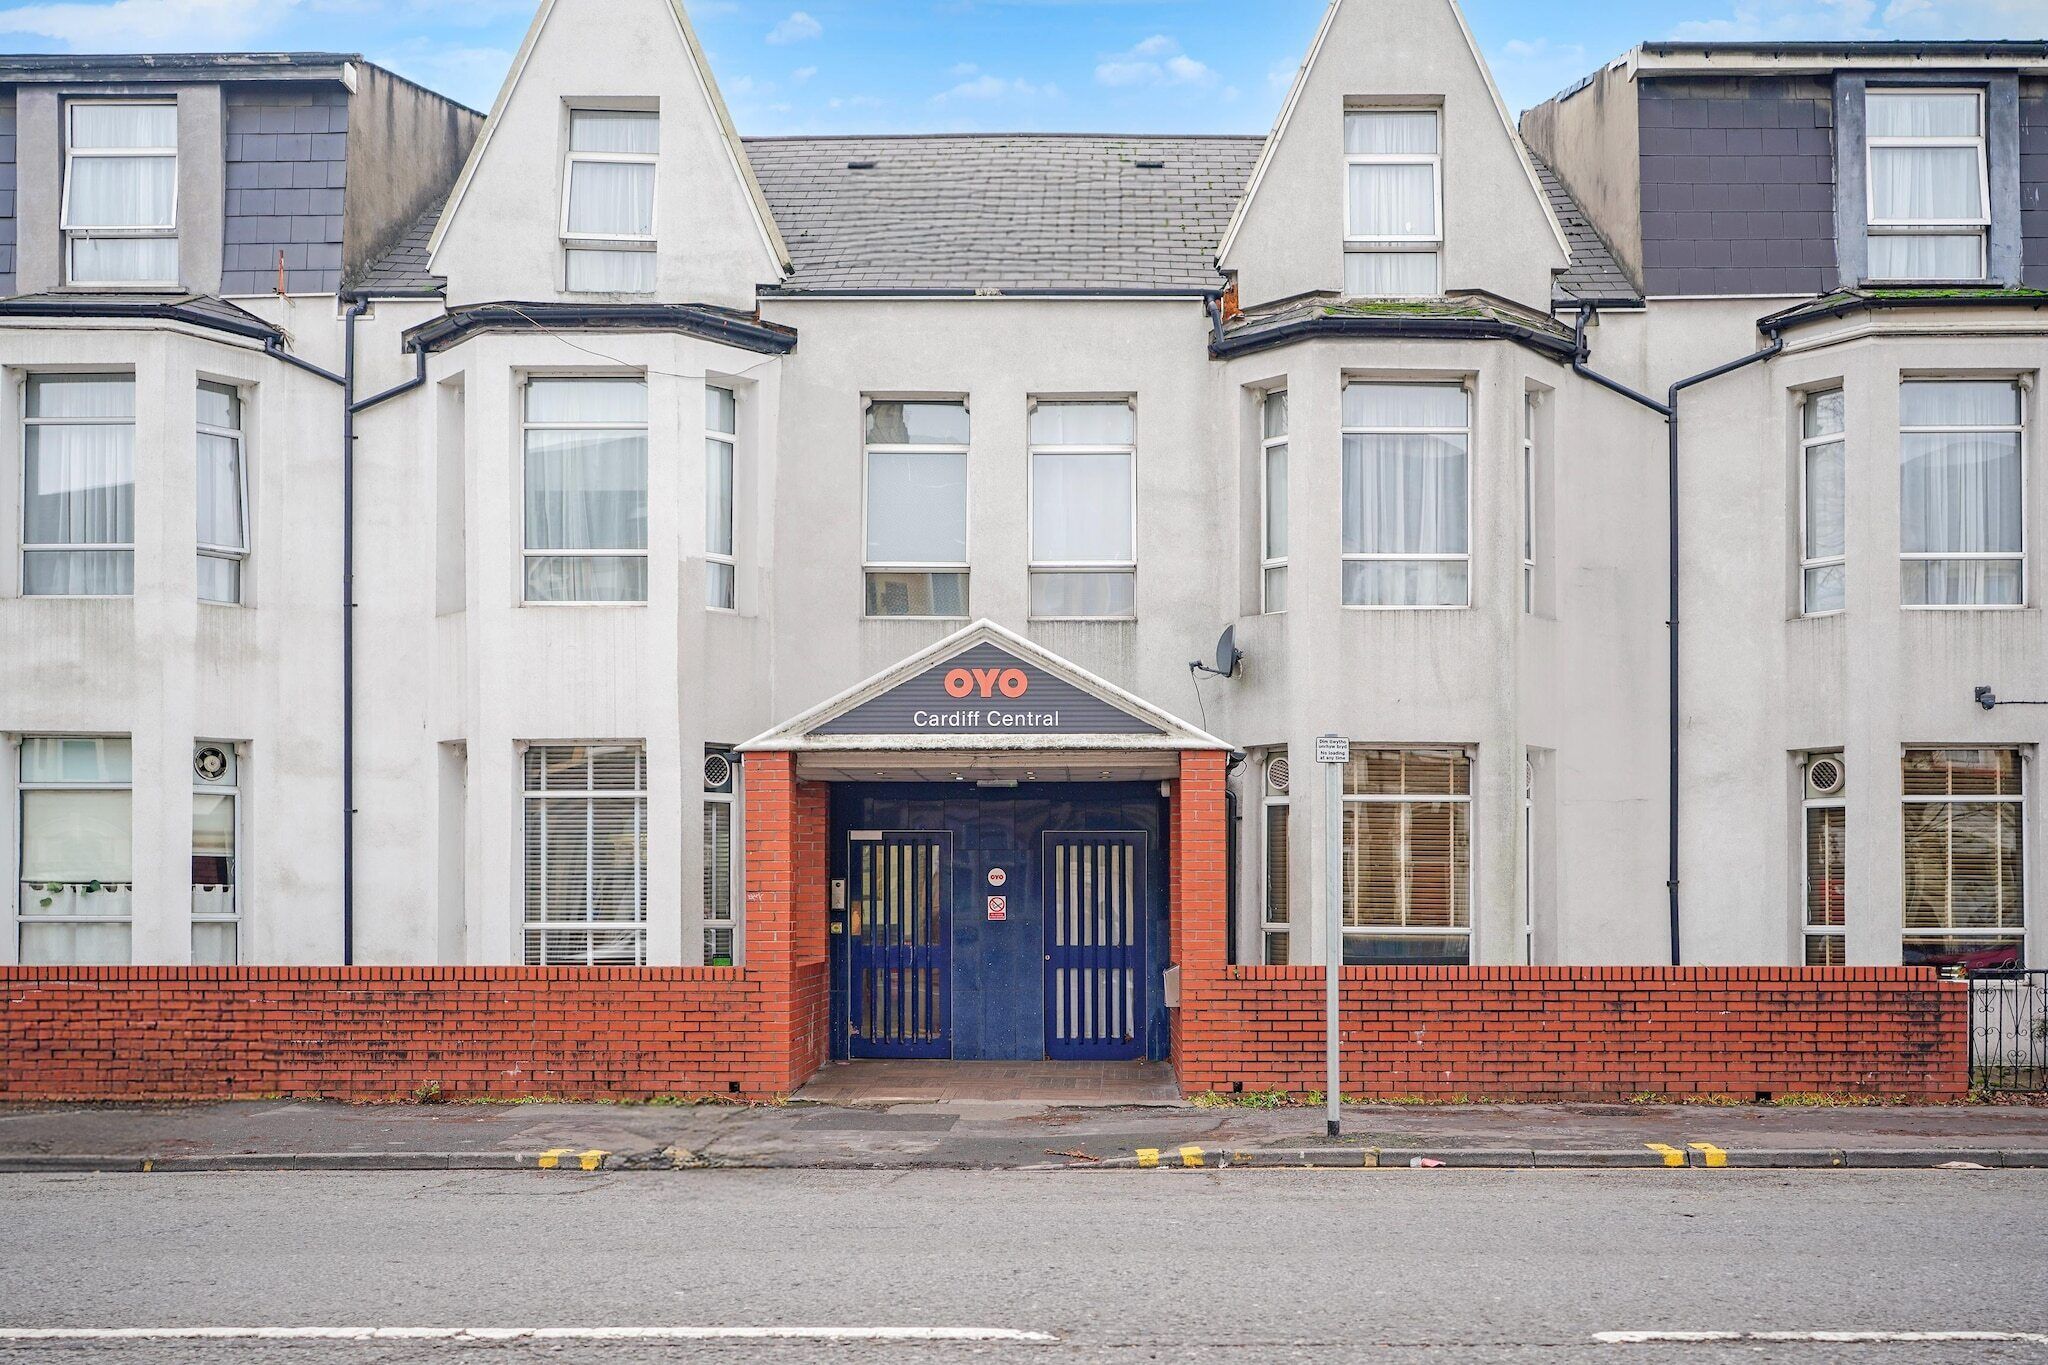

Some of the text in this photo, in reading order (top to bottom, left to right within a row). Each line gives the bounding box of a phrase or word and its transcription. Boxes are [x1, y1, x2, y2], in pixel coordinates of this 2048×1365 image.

[944, 668, 1028, 698] OYO
[913, 710, 1059, 727] Cardiff Central
